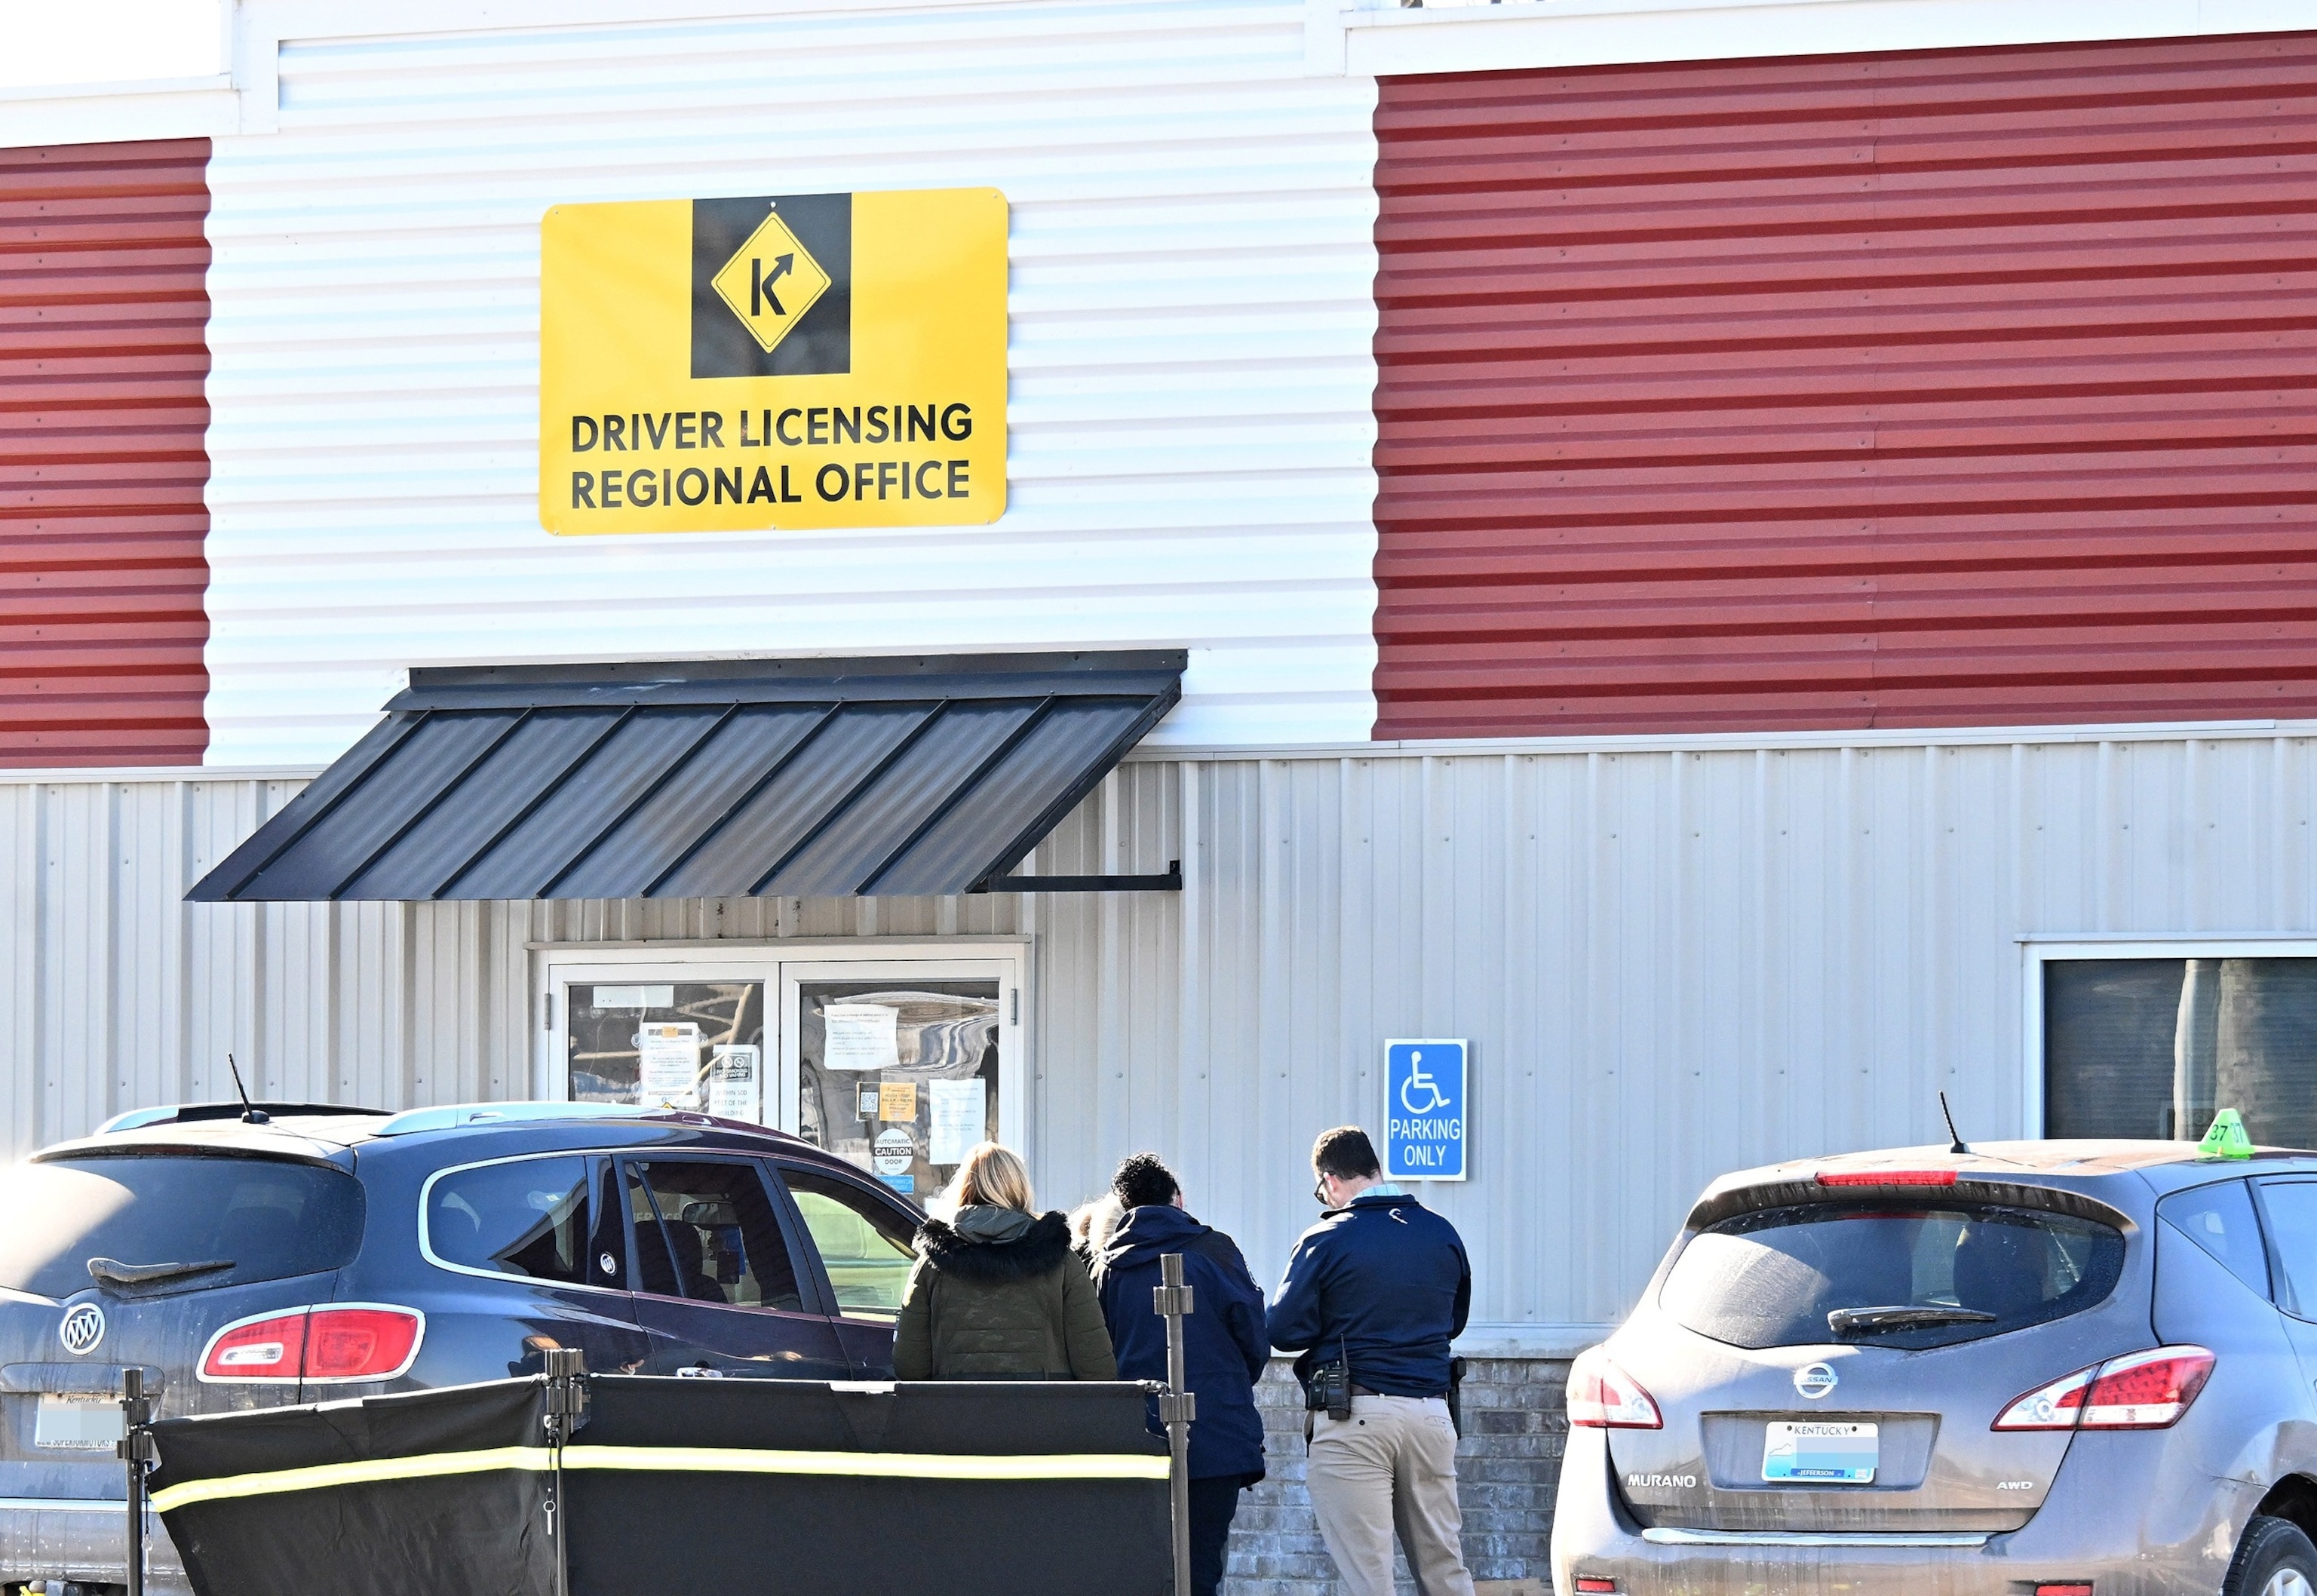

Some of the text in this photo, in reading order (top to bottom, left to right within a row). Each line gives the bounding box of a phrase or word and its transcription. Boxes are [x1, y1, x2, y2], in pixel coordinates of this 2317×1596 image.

[572, 404, 972, 453] DRIVER LICENSING
[572, 460, 969, 509] REGIONAL OFFICE
[1390, 1119, 1461, 1140] PARKING
[2209, 1124, 2228, 1141] 37
[1404, 1145, 1447, 1166] ONLY
[66, 1395, 103, 1404] Kentucky
[1794, 1426, 1850, 1435] KENTUCKY
[1628, 1474, 1696, 1488] MURANO
[1996, 1481, 2033, 1490] AWD
